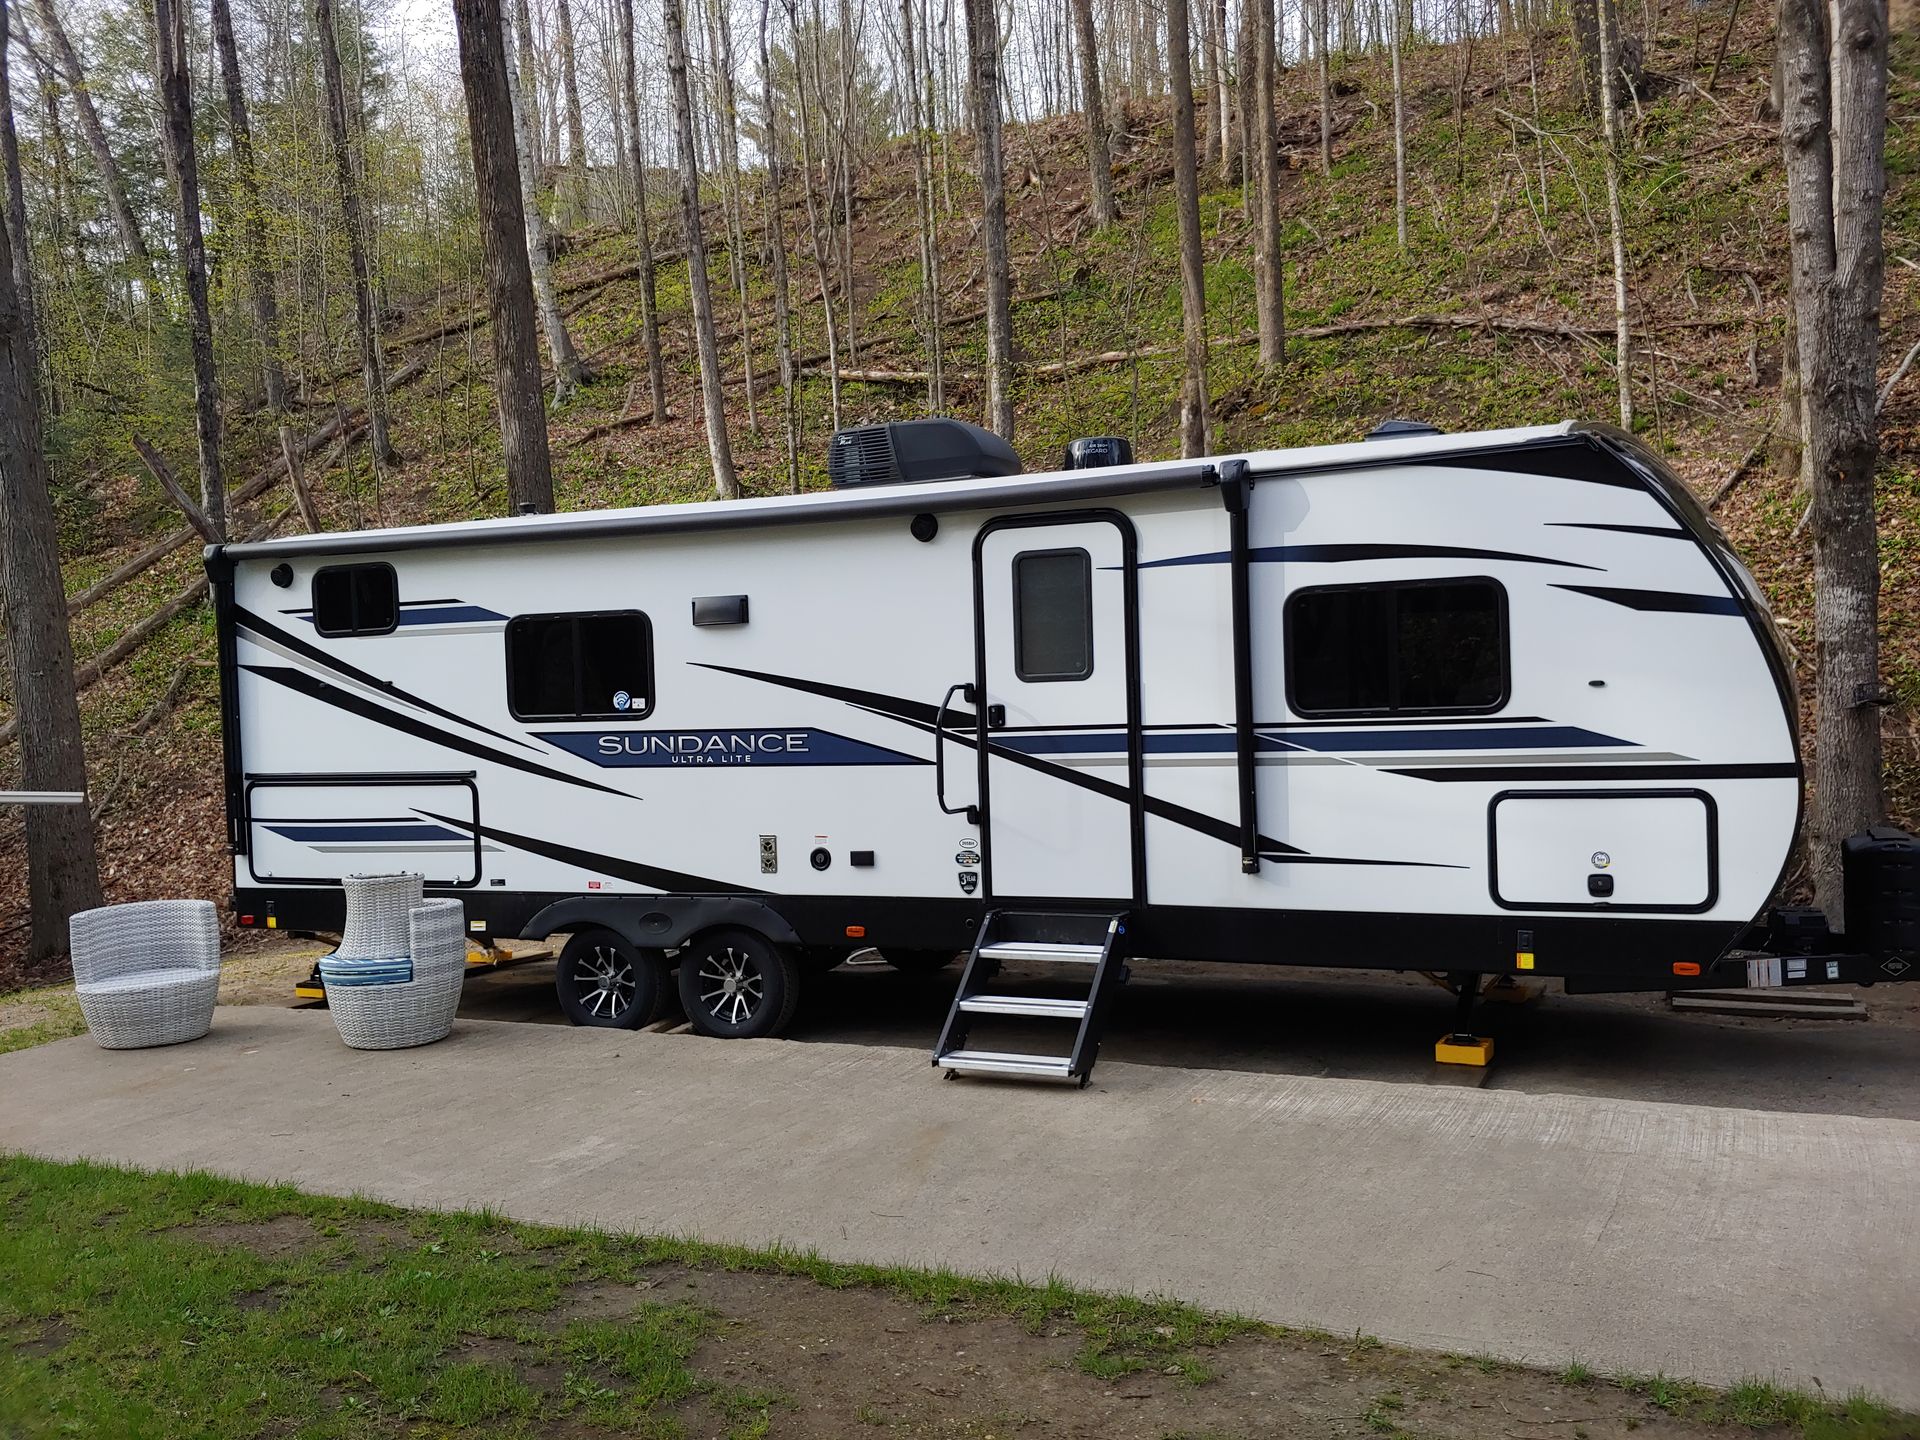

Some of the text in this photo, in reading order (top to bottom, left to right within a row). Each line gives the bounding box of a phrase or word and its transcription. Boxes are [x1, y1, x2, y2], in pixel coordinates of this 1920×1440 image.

[598, 733, 809, 755] SUNDANCE
[671, 754, 752, 763] ULTRA LITE
[961, 873, 967, 884] 3
